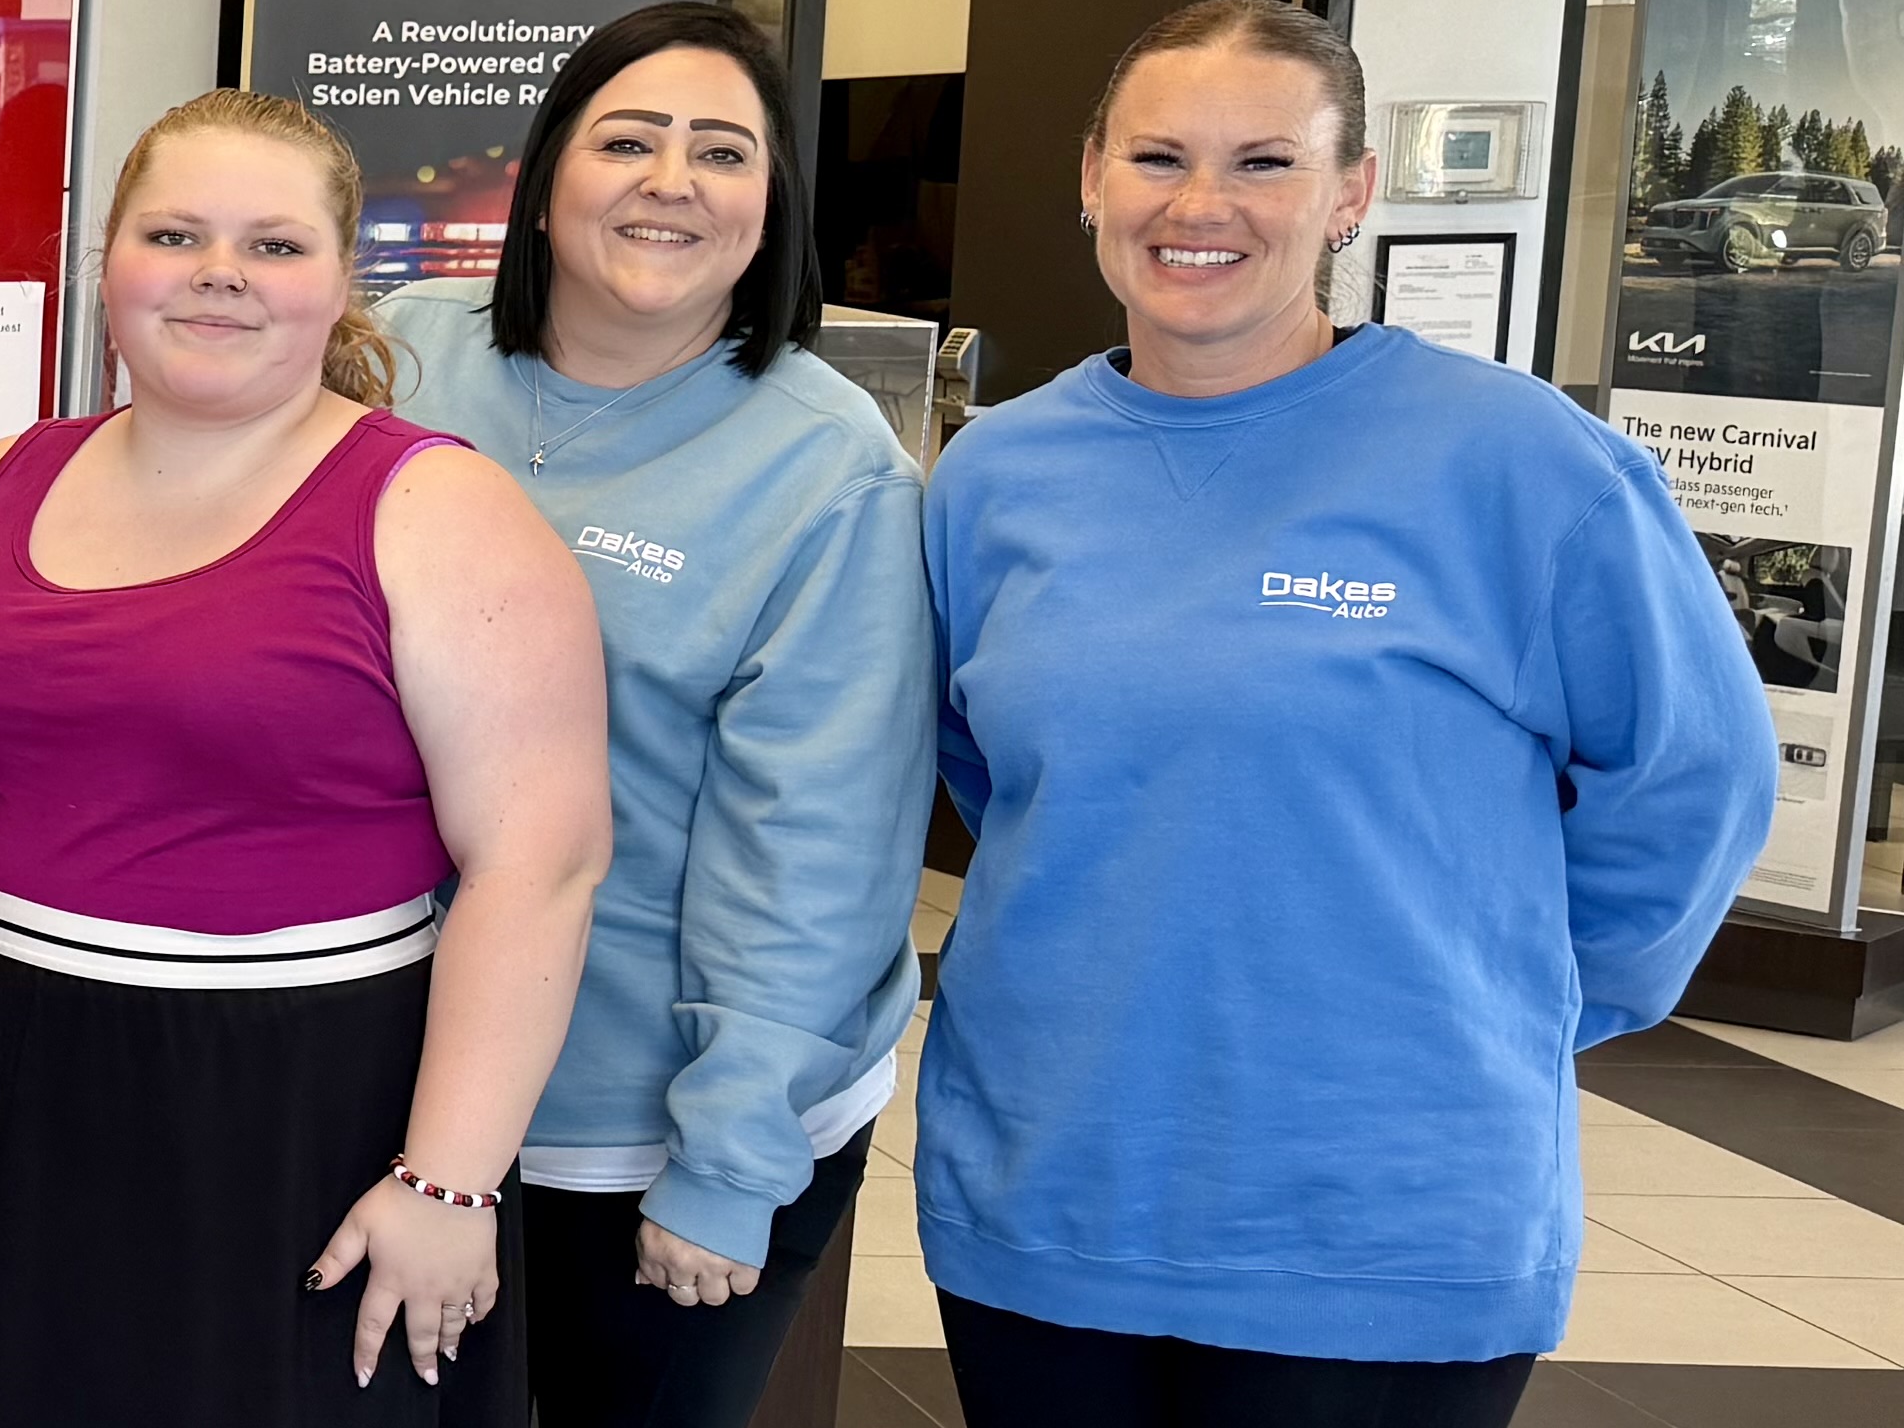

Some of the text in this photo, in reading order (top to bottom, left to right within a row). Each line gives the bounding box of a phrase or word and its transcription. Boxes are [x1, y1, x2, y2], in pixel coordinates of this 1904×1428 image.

[373, 19, 595, 48] A Revolutionary
[307, 51, 545, 79] Battery-Powered
[312, 83, 400, 106] Stolen
[408, 83, 511, 106] Vehicle
[1622, 416, 1817, 451] The new Carnival
[1677, 448, 1754, 475] Hybrid
[1704, 481, 1774, 501] passenger
[1686, 496, 1746, 515] next-gen
[577, 526, 686, 571] Oakes
[626, 559, 673, 584] Auto
[1261, 571, 1396, 602] Oakes
[1331, 602, 1388, 619] Auto
